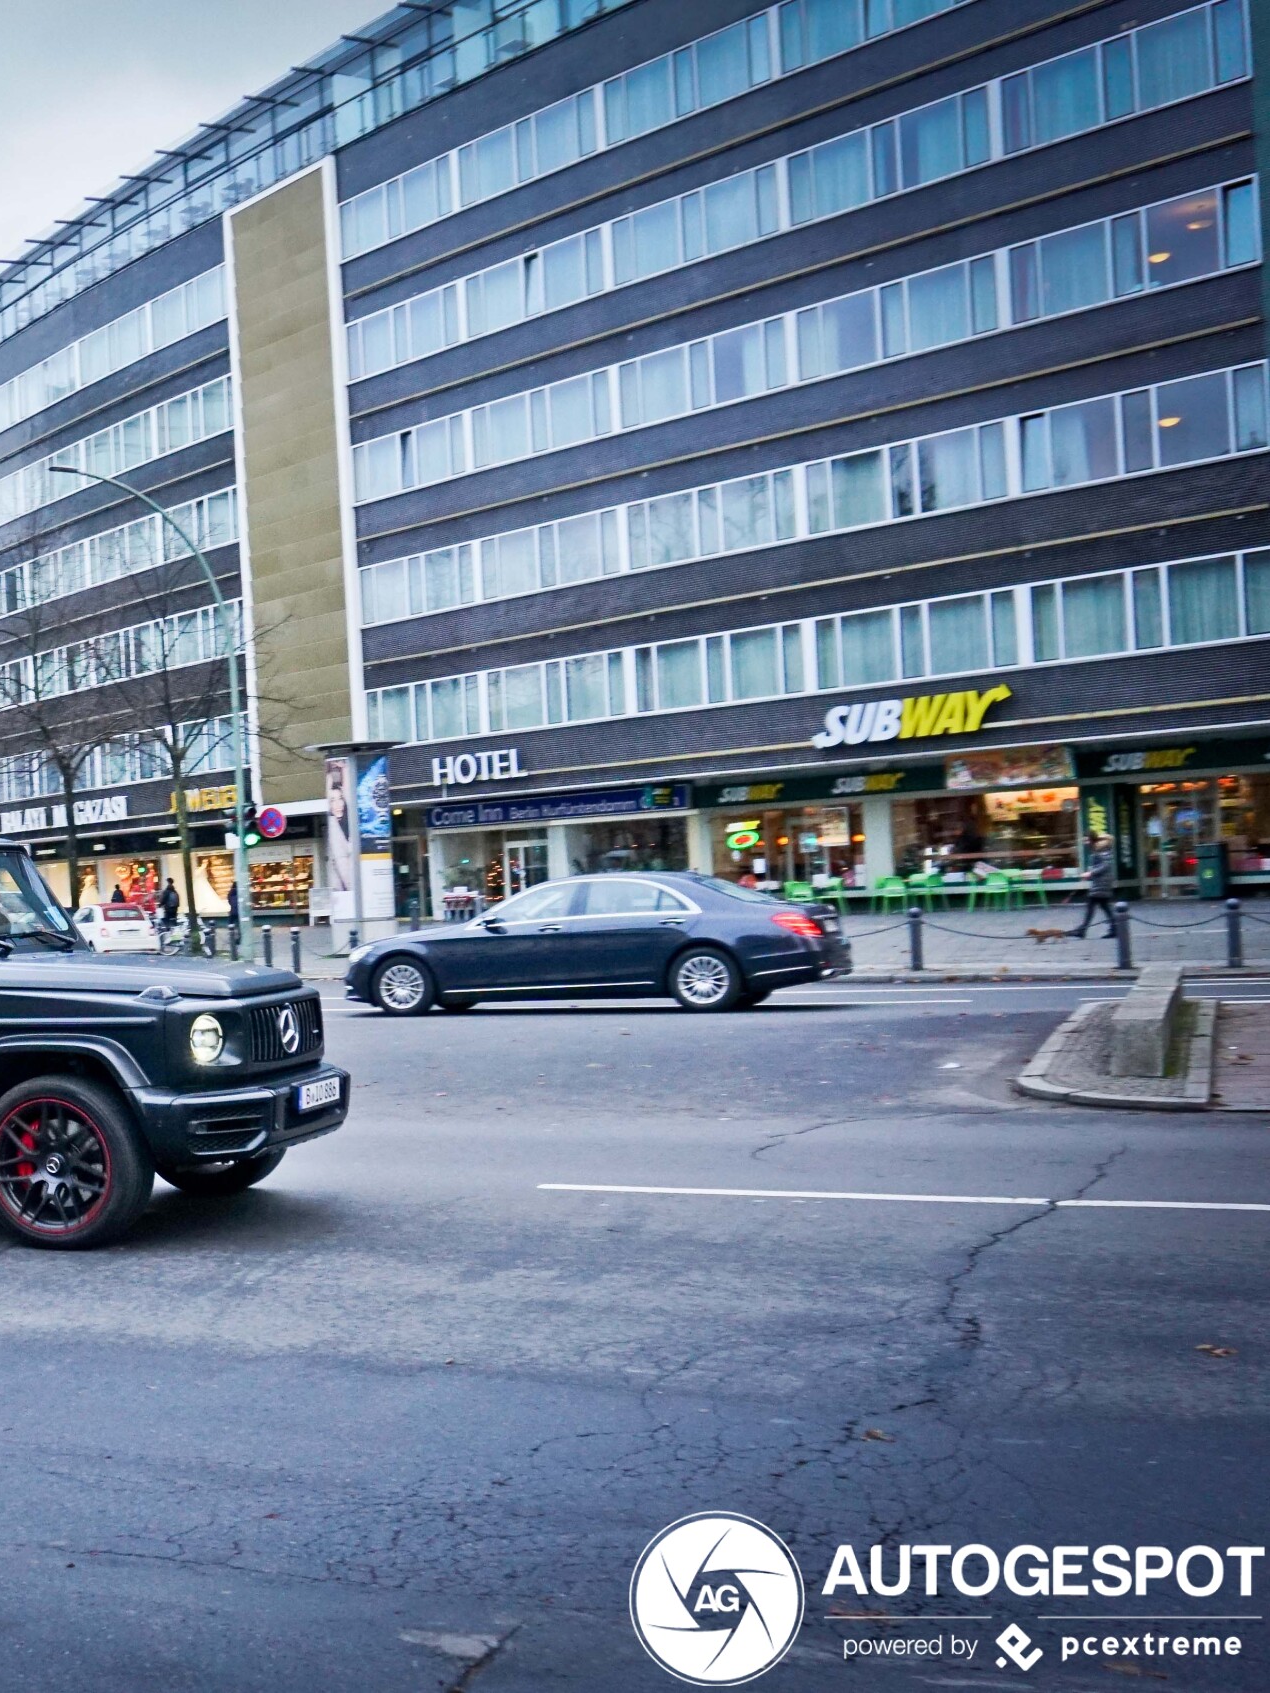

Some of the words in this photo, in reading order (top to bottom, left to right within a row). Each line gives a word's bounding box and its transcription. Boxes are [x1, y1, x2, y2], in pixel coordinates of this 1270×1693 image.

[812, 683, 1013, 749] SUBWAY
[432, 749, 529, 786] HOTEL
[1101, 747, 1197, 773] SUBWAY
[718, 783, 785, 803] SUBWAY
[831, 772, 906, 794] SUBWAY
[431, 807, 476, 826] Come
[477, 804, 503, 822] Inn
